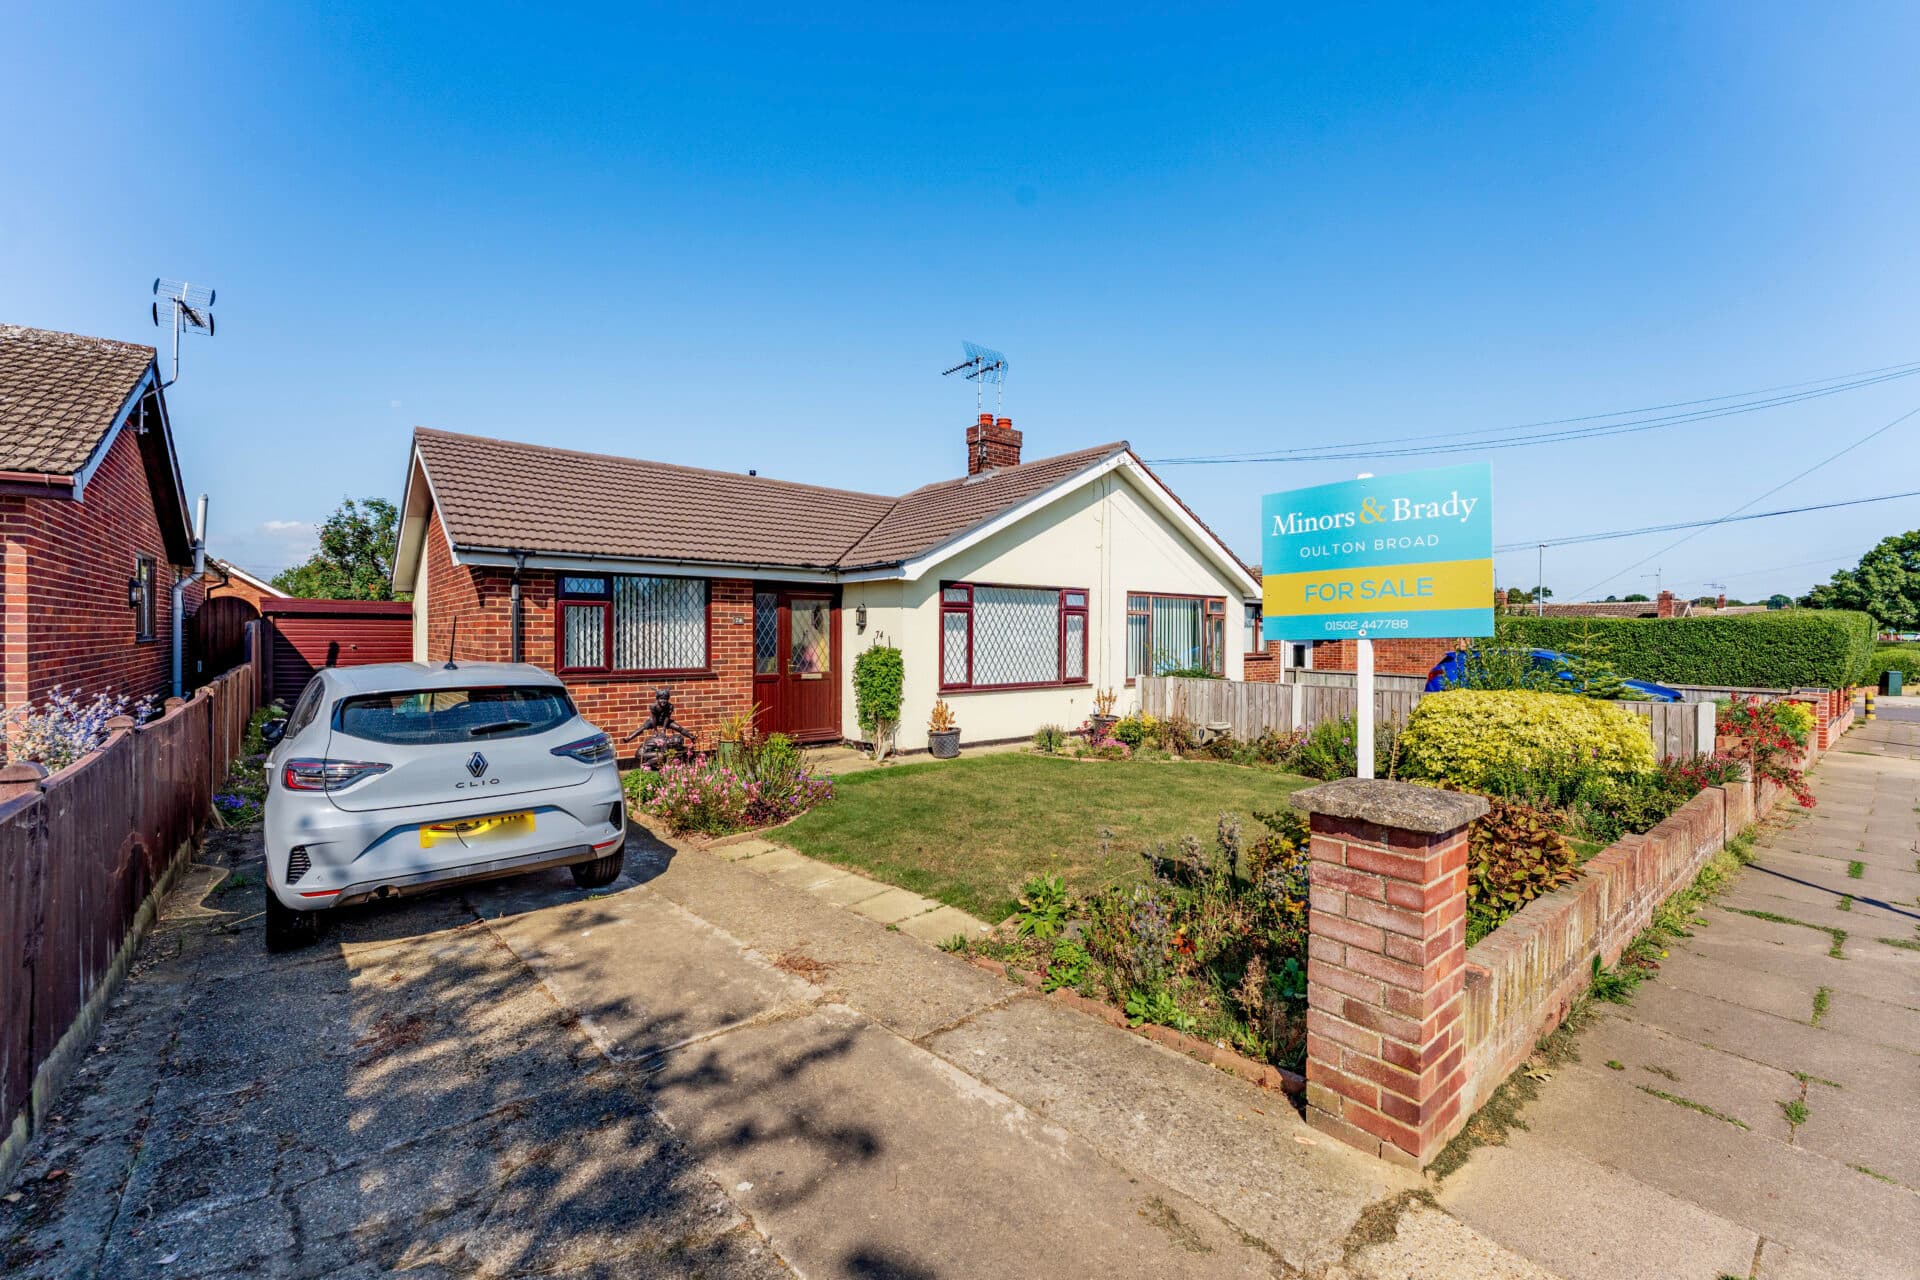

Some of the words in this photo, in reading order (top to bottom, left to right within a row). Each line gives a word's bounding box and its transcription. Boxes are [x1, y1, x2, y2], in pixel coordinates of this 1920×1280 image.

[1271, 511, 1355, 536] Minors
[1359, 497, 1386, 524] &
[1392, 490, 1478, 523] Brady
[1300, 541, 1366, 558] OULTON
[1374, 534, 1440, 551] BROAD
[1305, 581, 1353, 603] FOR
[1360, 577, 1434, 600] SALE
[1325, 620, 1358, 631] 01502
[1361, 619, 1409, 630] 447788
[875, 630, 884, 640] 74
[455, 778, 500, 789] CLIO
